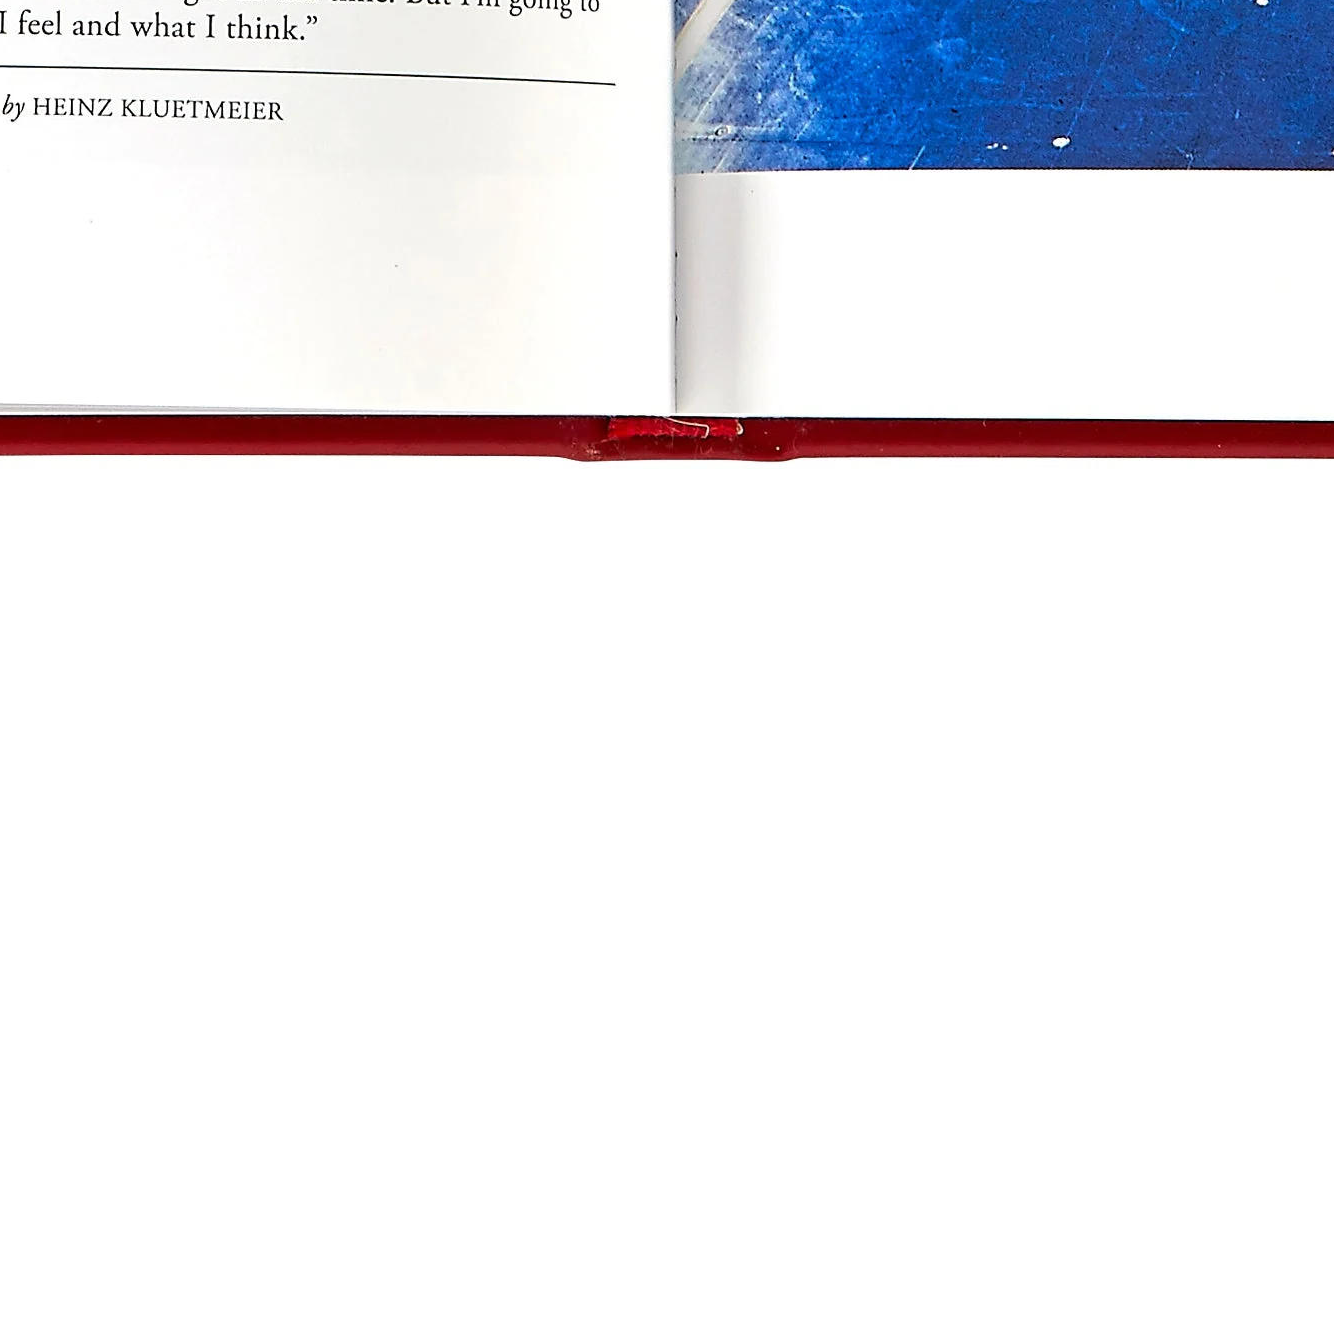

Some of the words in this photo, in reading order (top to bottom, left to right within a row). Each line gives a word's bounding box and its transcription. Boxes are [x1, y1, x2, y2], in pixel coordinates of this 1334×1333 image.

[1, 93, 26, 123] by
[33, 97, 114, 117] HEINZ
[121, 98, 284, 121] KLUETMEIER
